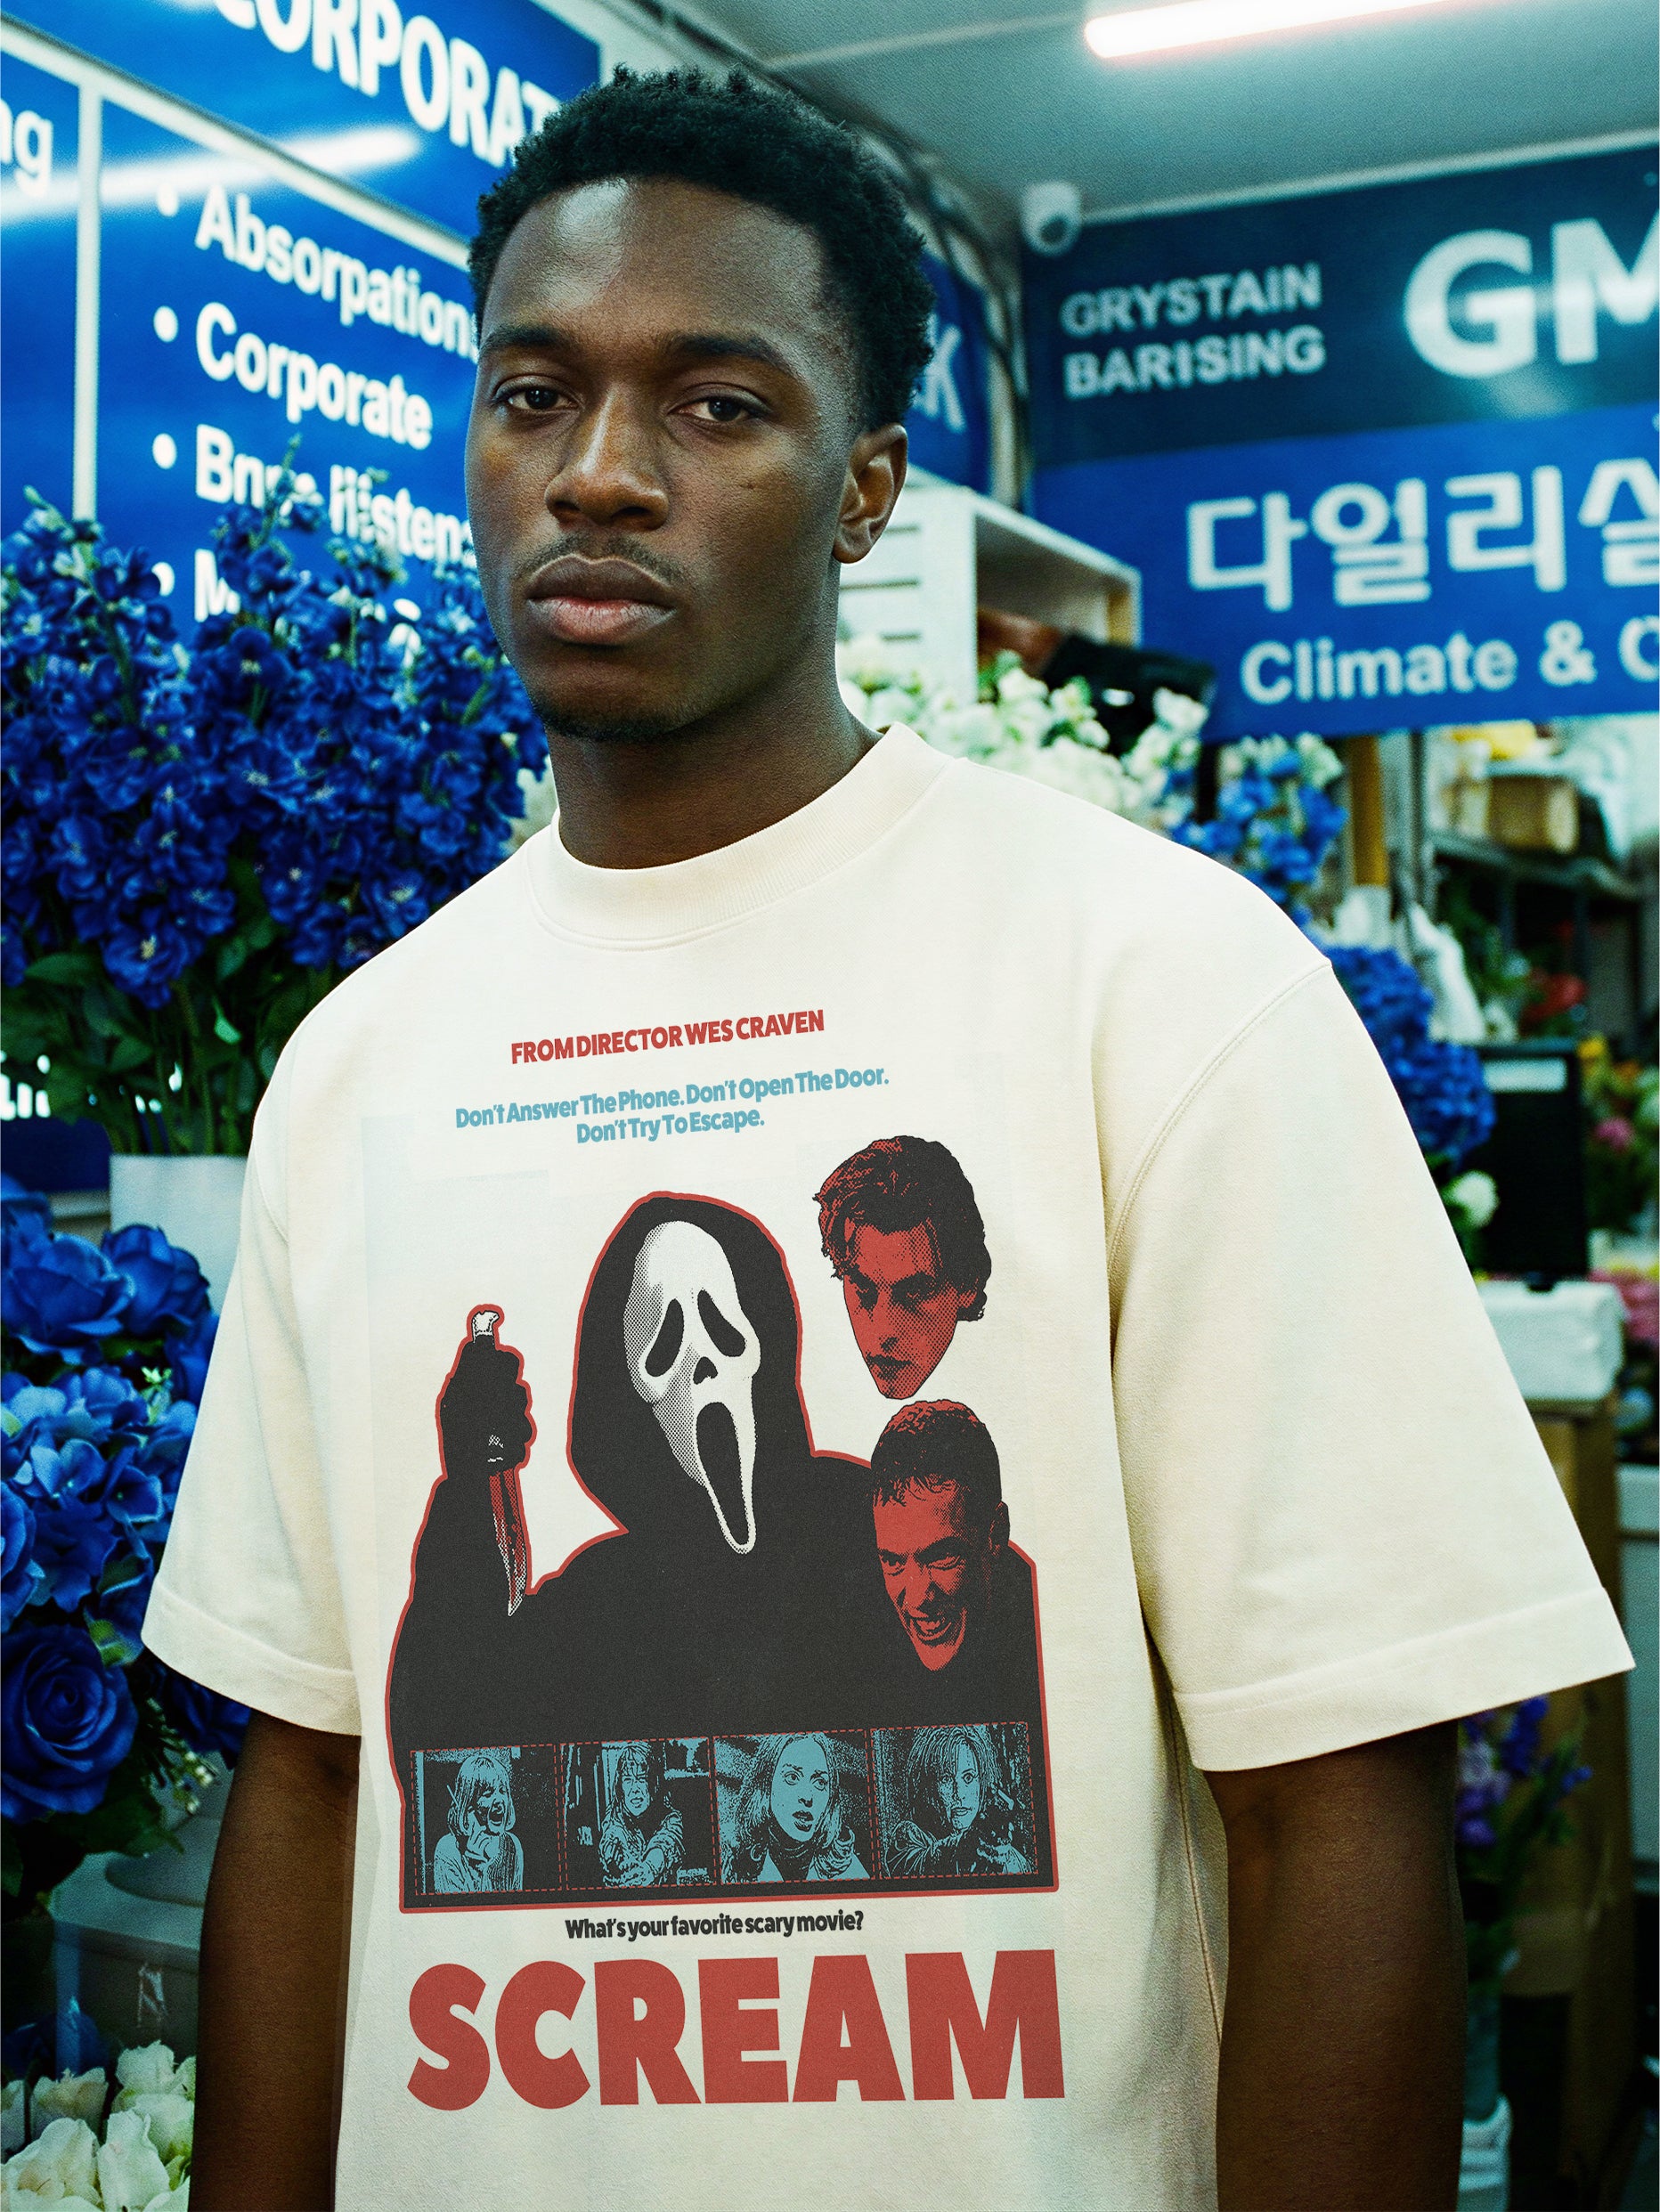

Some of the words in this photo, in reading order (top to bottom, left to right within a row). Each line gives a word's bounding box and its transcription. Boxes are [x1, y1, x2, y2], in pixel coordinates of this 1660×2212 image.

[216, 0, 561, 167] RPORAT
[195, 183, 479, 364] Absorpation
[1060, 261, 1322, 338] GRYSTAIN
[196, 301, 433, 450] Corporate
[1063, 324, 1326, 400] BARISING
[1241, 630, 1518, 704] Climate
[1539, 620, 1598, 687] &
[511, 1037, 574, 1064] FROM
[576, 1025, 683, 1057] DIRECTOR
[684, 1020, 733, 1045] WES
[736, 1009, 825, 1040] CRAVEN
[456, 1104, 505, 1128] Don't
[506, 1100, 579, 1123] Answer
[580, 1094, 617, 1115] The
[618, 1089, 685, 1111] Phone.
[686, 1080, 736, 1104] Don't
[738, 1078, 794, 1102] Open
[794, 1070, 833, 1093] The
[834, 1068, 889, 1089] Door.
[577, 1120, 627, 1143] Don't
[627, 1118, 661, 1142] Try
[662, 1114, 688, 1134] To
[689, 1110, 765, 1133] Escape.
[565, 1918, 626, 1939] What's
[627, 1921, 669, 1941] your
[671, 1913, 744, 1936] favorite
[745, 1916, 794, 1938] scary
[796, 1909, 864, 1931] movie?
[407, 1949, 1065, 2111] SCREAM
